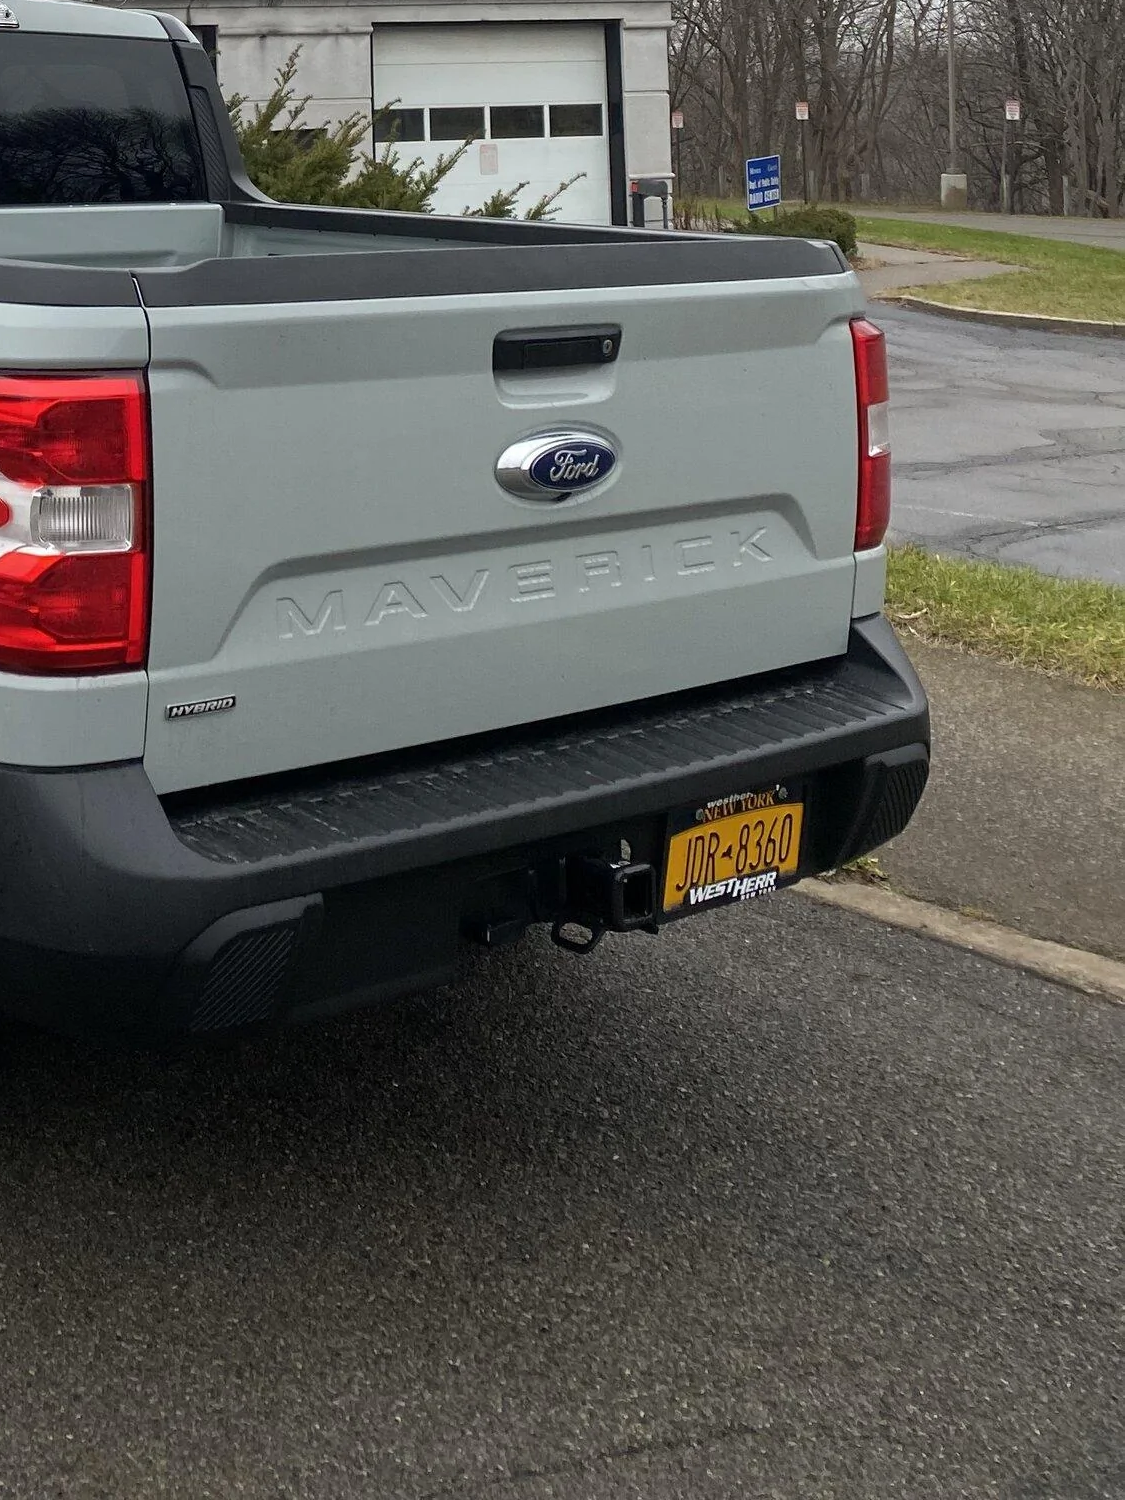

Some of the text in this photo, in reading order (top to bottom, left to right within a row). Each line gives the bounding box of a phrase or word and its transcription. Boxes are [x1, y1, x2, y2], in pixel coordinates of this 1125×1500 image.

[549, 448, 600, 482] Ford
[276, 527, 773, 639] MAVERICK
[171, 698, 234, 717] HYBRID
[676, 813, 794, 891] JDR 8360
